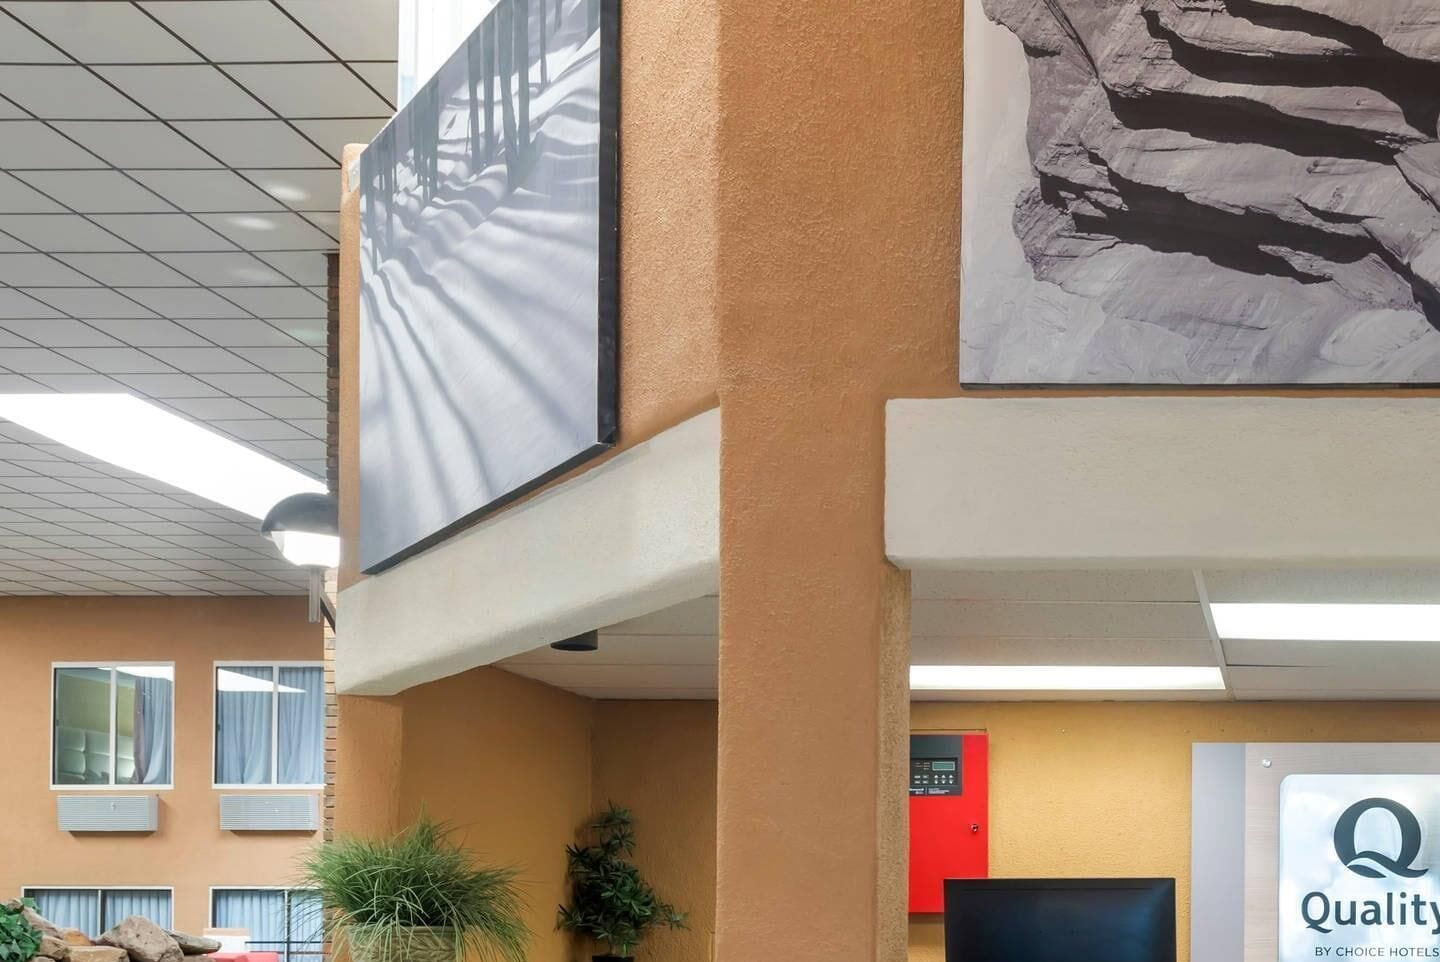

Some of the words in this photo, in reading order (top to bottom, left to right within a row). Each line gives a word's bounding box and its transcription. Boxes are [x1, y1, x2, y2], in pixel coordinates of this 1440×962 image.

[1333, 797, 1429, 878] Q
[1315, 947, 1332, 957] BY
[1336, 947, 1385, 957] CHOICE
[1390, 947, 1440, 957] HOTELS
